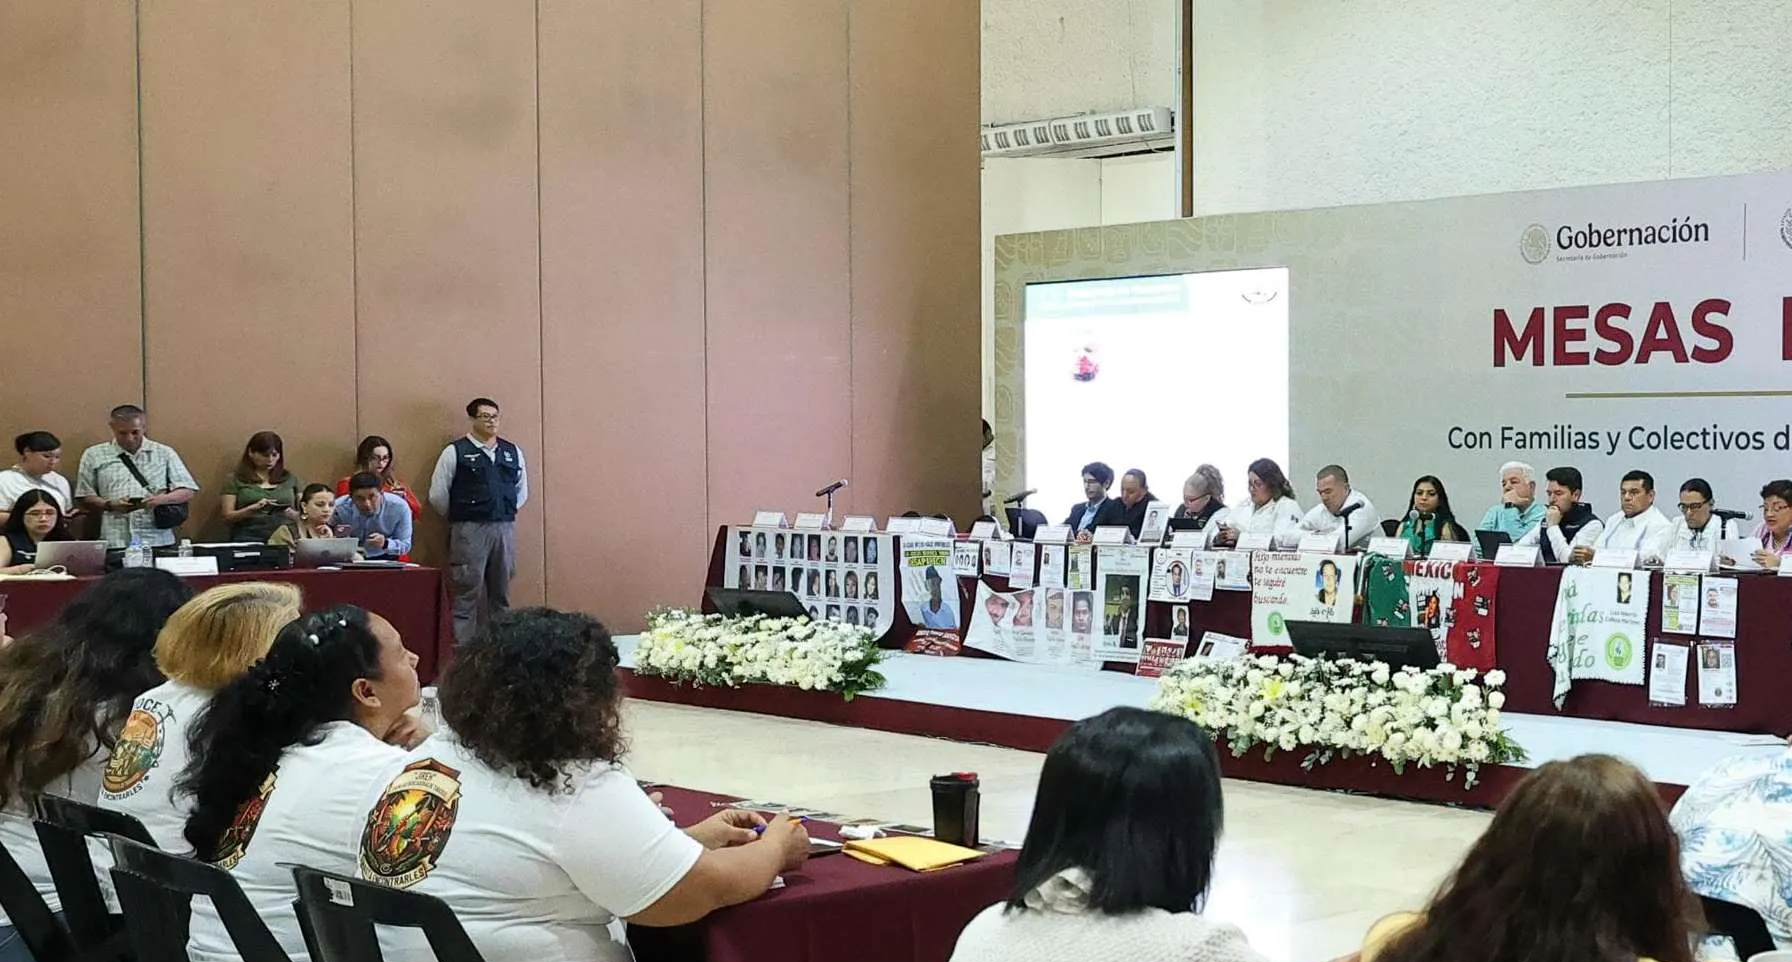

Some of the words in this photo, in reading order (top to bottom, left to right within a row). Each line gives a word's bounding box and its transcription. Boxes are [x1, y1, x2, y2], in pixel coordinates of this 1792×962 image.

[1556, 215, 1709, 251] Gobernación
[1493, 298, 1734, 368] MESAS
[1447, 426, 1493, 450] Con
[1500, 424, 1601, 451] Familias
[1606, 431, 1622, 456] y
[1627, 424, 1766, 452] Colectivos
